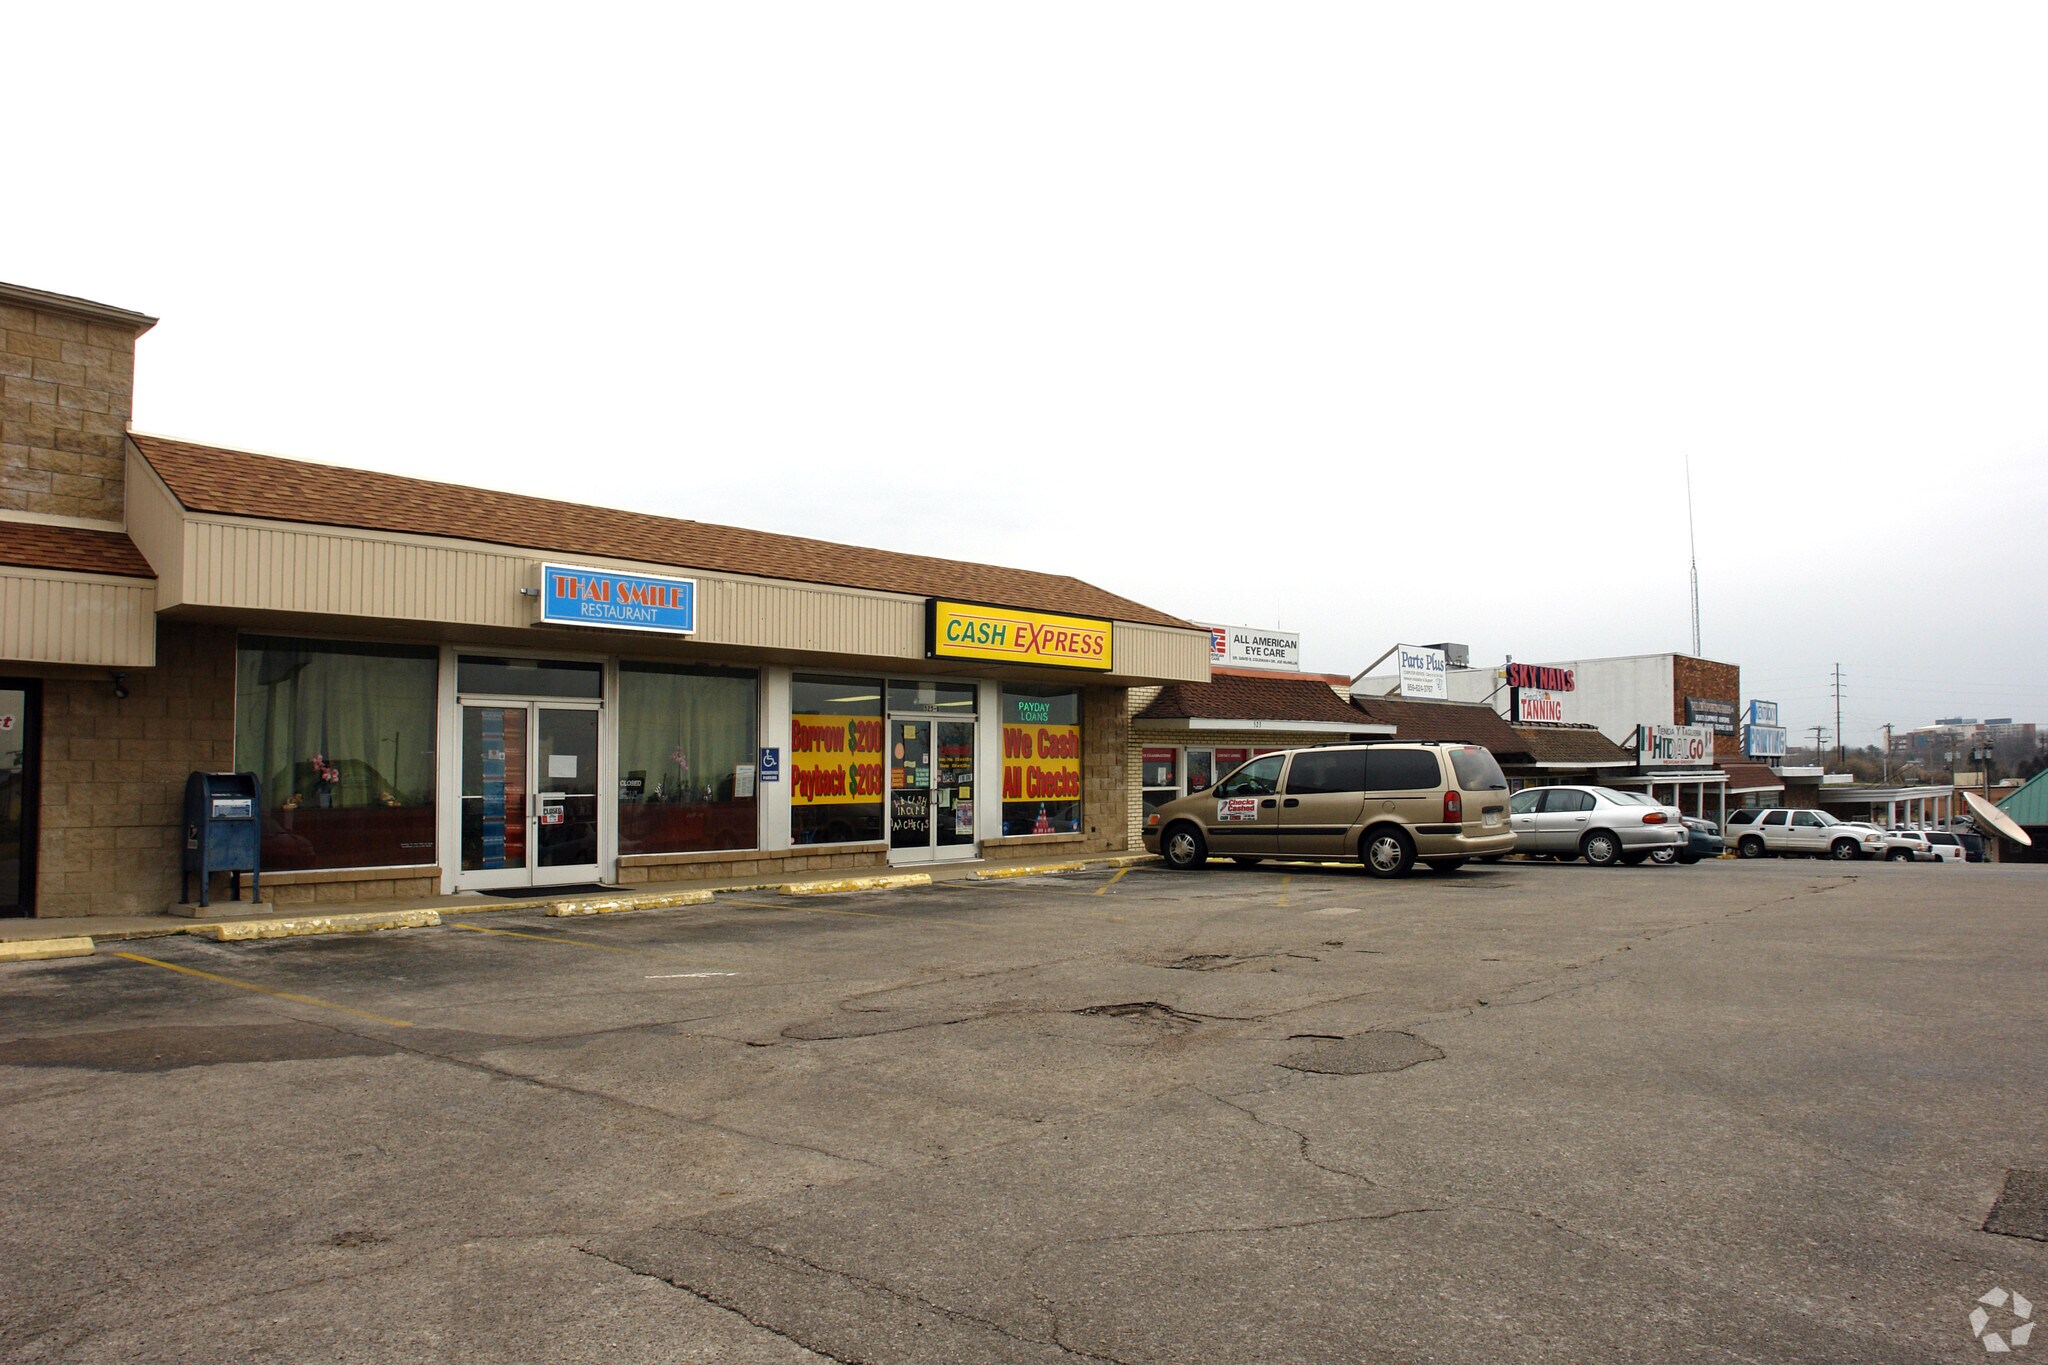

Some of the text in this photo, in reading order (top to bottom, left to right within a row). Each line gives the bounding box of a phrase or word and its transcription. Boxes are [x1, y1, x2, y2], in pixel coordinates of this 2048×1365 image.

[552, 575, 684, 609] THAI SMILE
[581, 602, 658, 622] RESTAURANT
[946, 619, 1104, 656] CASH EXPRESS
[1233, 634, 1297, 650] ALL AMERICAN
[1245, 646, 1286, 658] EYE CARE
[1401, 651, 1445, 672] Parts Plus
[1510, 662, 1575, 692] SKY NAILS
[1018, 701, 1050, 712] PAYDAY
[1020, 711, 1049, 722] LOANS
[1521, 698, 1561, 721] TANNING
[792, 718, 882, 756] Borrow $200
[1003, 728, 1080, 759] We Cash
[1652, 735, 1704, 760] HIDALGO
[1750, 728, 1785, 755] PRINTING
[620, 779, 642, 787] CLOSED
[792, 764, 846, 802] Payback
[849, 761, 882, 800] $203
[1002, 765, 1080, 798] All Checks
[543, 807, 563, 816] CLOSED
